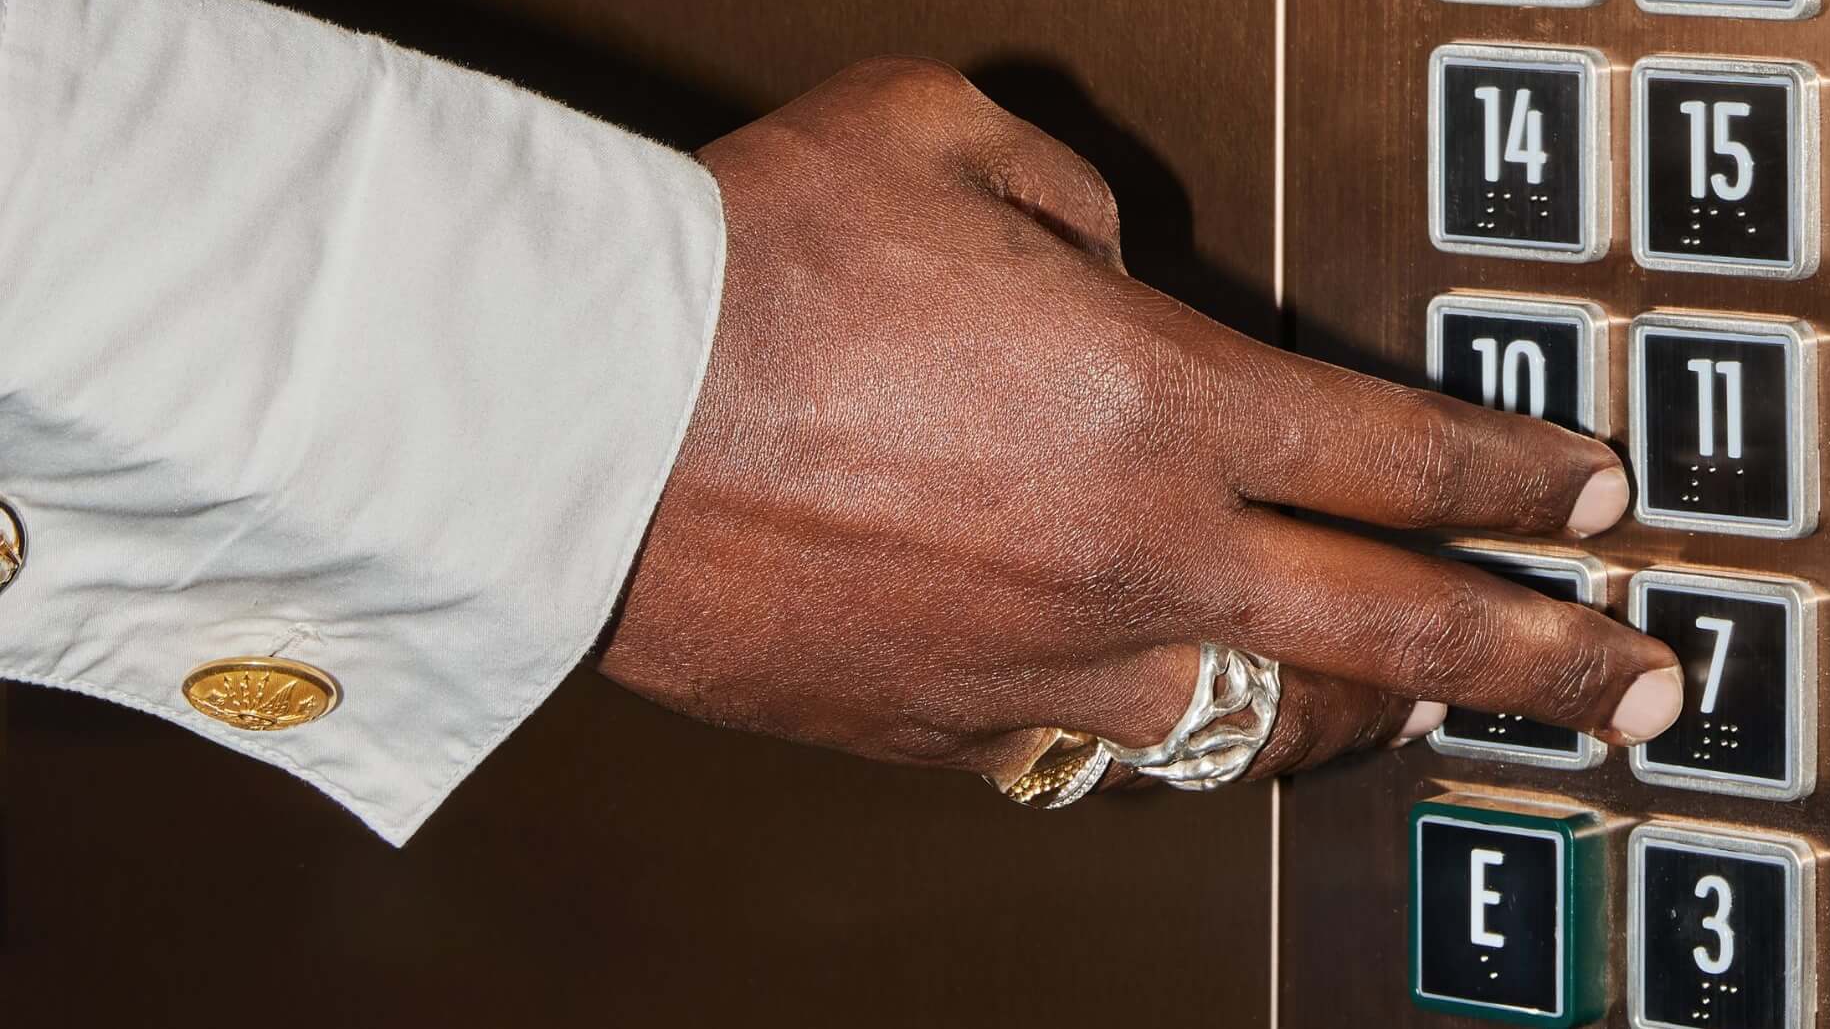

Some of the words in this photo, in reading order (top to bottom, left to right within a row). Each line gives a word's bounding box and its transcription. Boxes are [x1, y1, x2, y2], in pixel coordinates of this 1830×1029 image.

[1475, 86, 1546, 184] 14
[1680, 100, 1753, 200] 15
[1472, 338, 1545, 418] 10
[1688, 358, 1743, 459] 11
[1696, 616, 1733, 713] 7
[1470, 848, 1503, 947] E
[1693, 875, 1733, 975] 3
